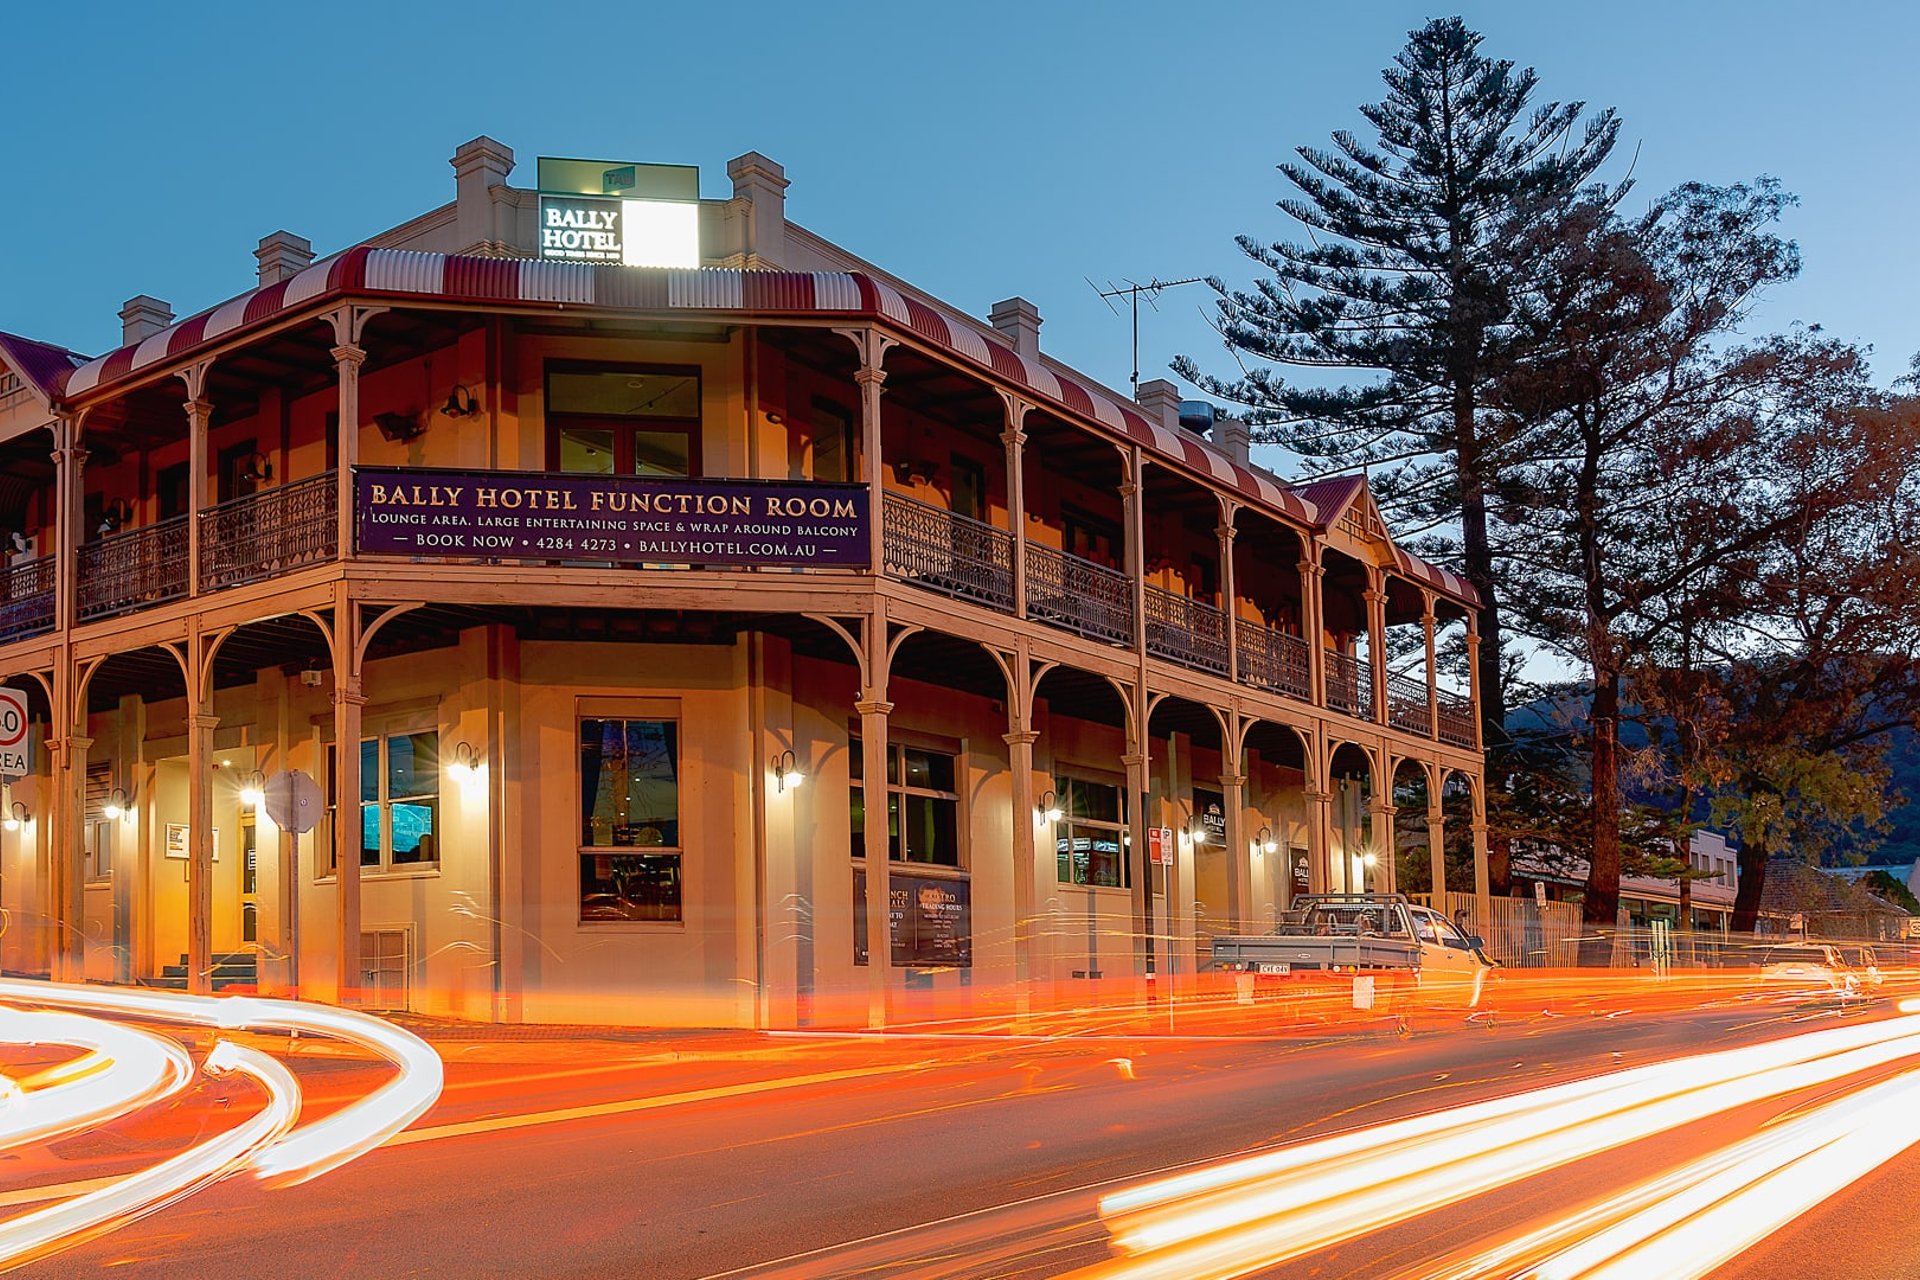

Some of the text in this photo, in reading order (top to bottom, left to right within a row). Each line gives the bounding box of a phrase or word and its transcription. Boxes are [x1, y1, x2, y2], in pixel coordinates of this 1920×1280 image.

[545, 208, 618, 230] BALLY
[542, 229, 621, 251] HOTEL
[371, 484, 858, 519] BALLY HOTEL FUNCTION ROOM
[372, 513, 427, 525] LOUNGE
[478, 516, 520, 528] LARGE
[526, 517, 627, 531] ENTERTAINING
[633, 521, 670, 532] SPACE
[675, 522, 686, 532] &
[690, 523, 729, 533] WRAP
[734, 524, 791, 535] AROUND
[797, 525, 858, 537] BALCONY
[416, 534, 816, 557] BOOK NOW 4284 4273 BALLYHOTEL.COM.AU
[0, 710, 18, 732] 0
[0, 753, 26, 769] EA
[1203, 814, 1226, 827] BALLY
[1294, 868, 1309, 877] BALL
